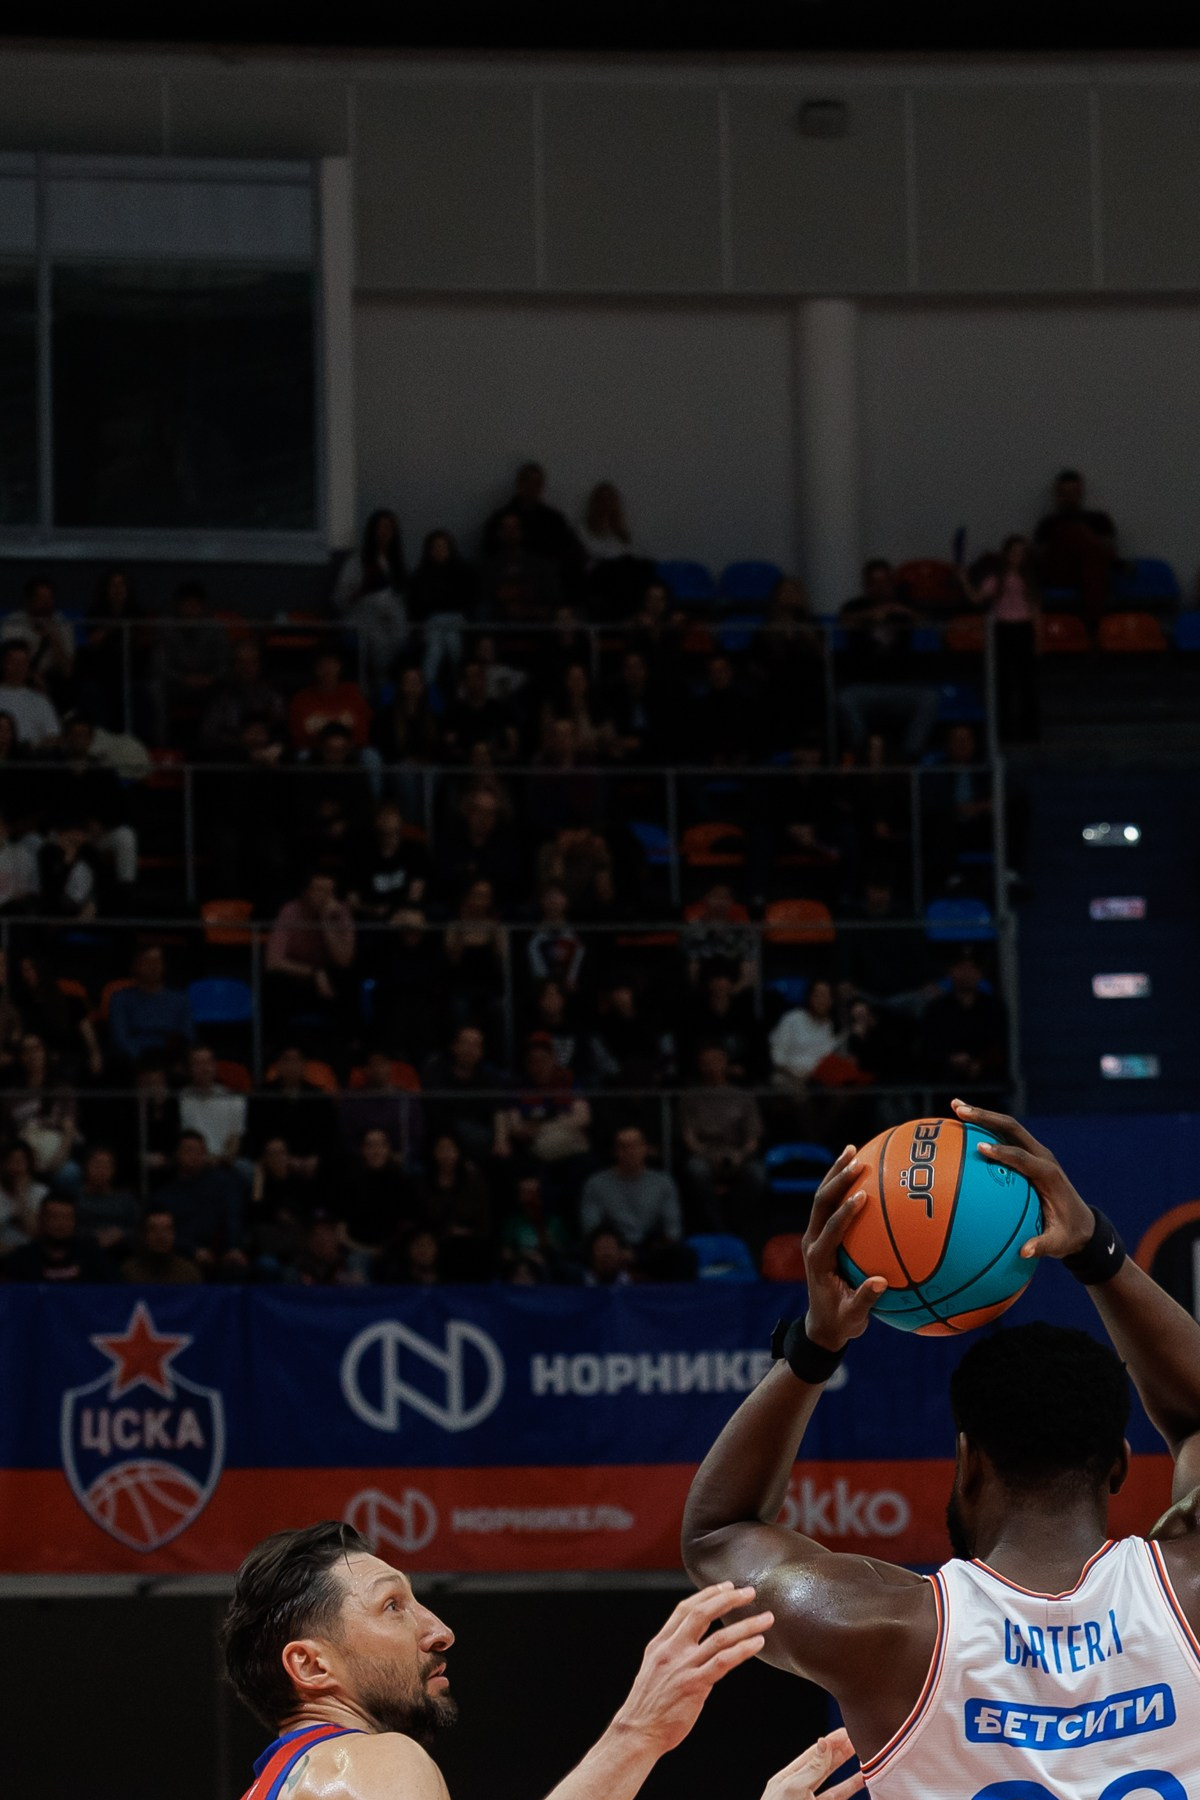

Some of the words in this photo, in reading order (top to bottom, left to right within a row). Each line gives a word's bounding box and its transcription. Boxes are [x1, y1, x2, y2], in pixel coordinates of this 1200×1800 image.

[530, 1350, 849, 1396] НОРНИКЕ
[80, 1406, 206, 1457] ЦСКА
[975, 1692, 1167, 1743] БЕТСИТИ
